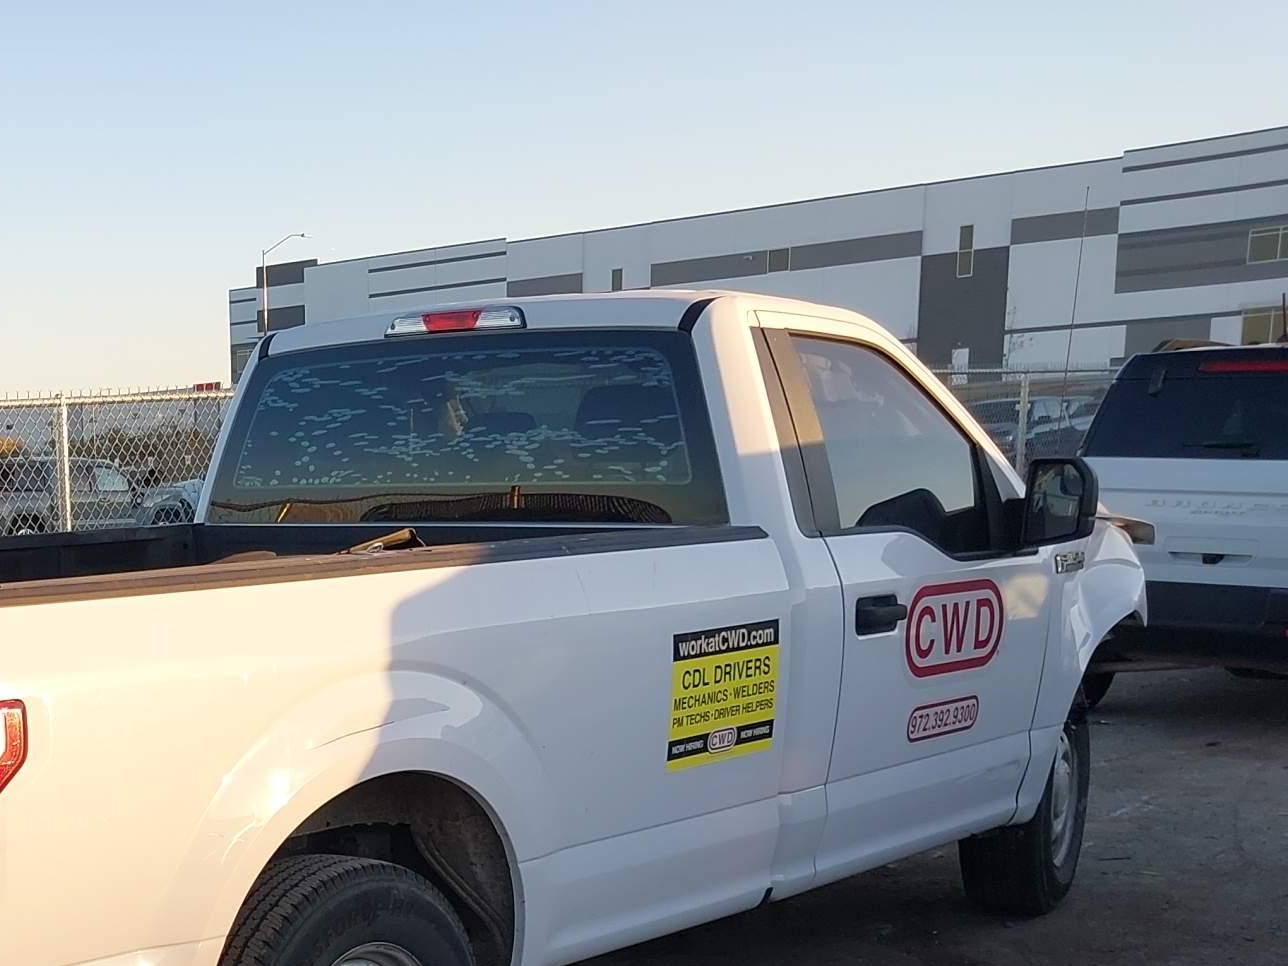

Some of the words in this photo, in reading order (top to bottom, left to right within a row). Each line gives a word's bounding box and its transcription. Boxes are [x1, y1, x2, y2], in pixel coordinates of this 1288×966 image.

[678, 627, 775, 657] workatCWD.com
[915, 598, 995, 659] CWD
[682, 668, 710, 690] CDL
[714, 656, 771, 684] DRIVERS
[673, 688, 729, 712] MECHANICS
[733, 679, 775, 700] WELDERS
[672, 716, 685, 729] PM
[685, 710, 711, 727] TECHS
[713, 704, 741, 721] DRIVER
[741, 697, 775, 714] HELPERS
[909, 702, 976, 736] 972.392.9300
[711, 730, 733, 747] CWD
